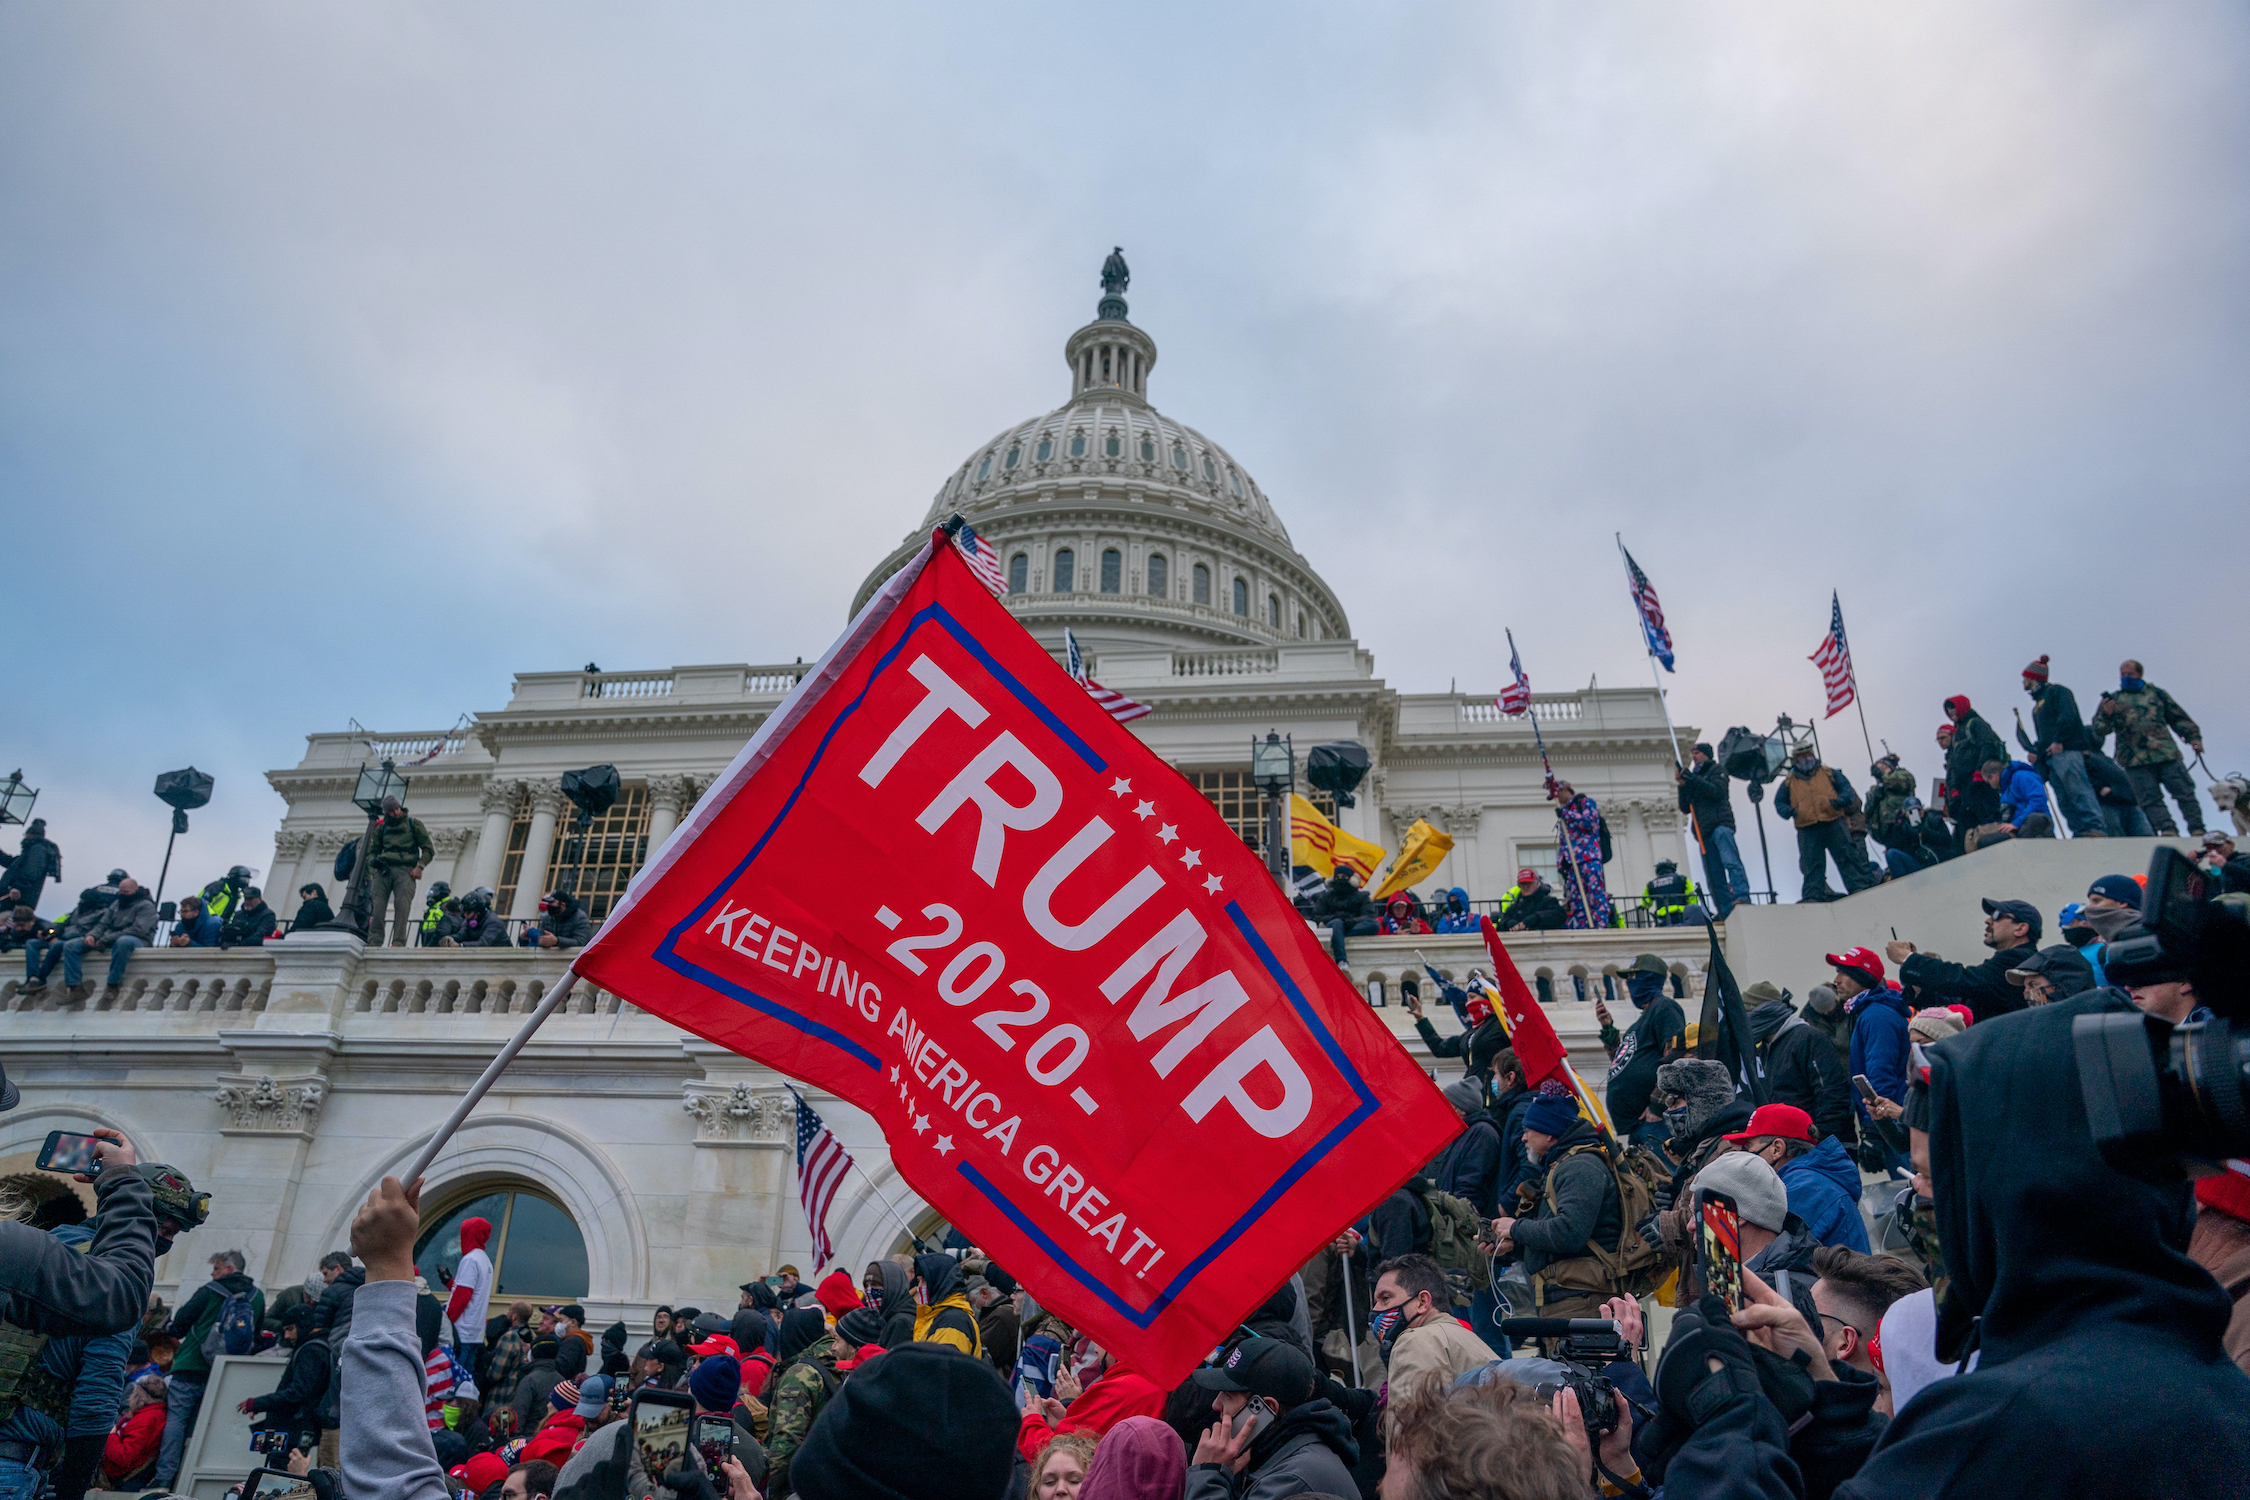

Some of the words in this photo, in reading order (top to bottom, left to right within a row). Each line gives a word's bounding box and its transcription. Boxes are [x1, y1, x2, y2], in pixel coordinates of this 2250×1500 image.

[858, 653, 1312, 1138] TRUMP
[874, 903, 1099, 1115] -2020-
[705, 900, 882, 1022] KEEPING
[886, 1007, 1021, 1156] AMERICA
[1023, 1145, 1165, 1279] GREAT!
